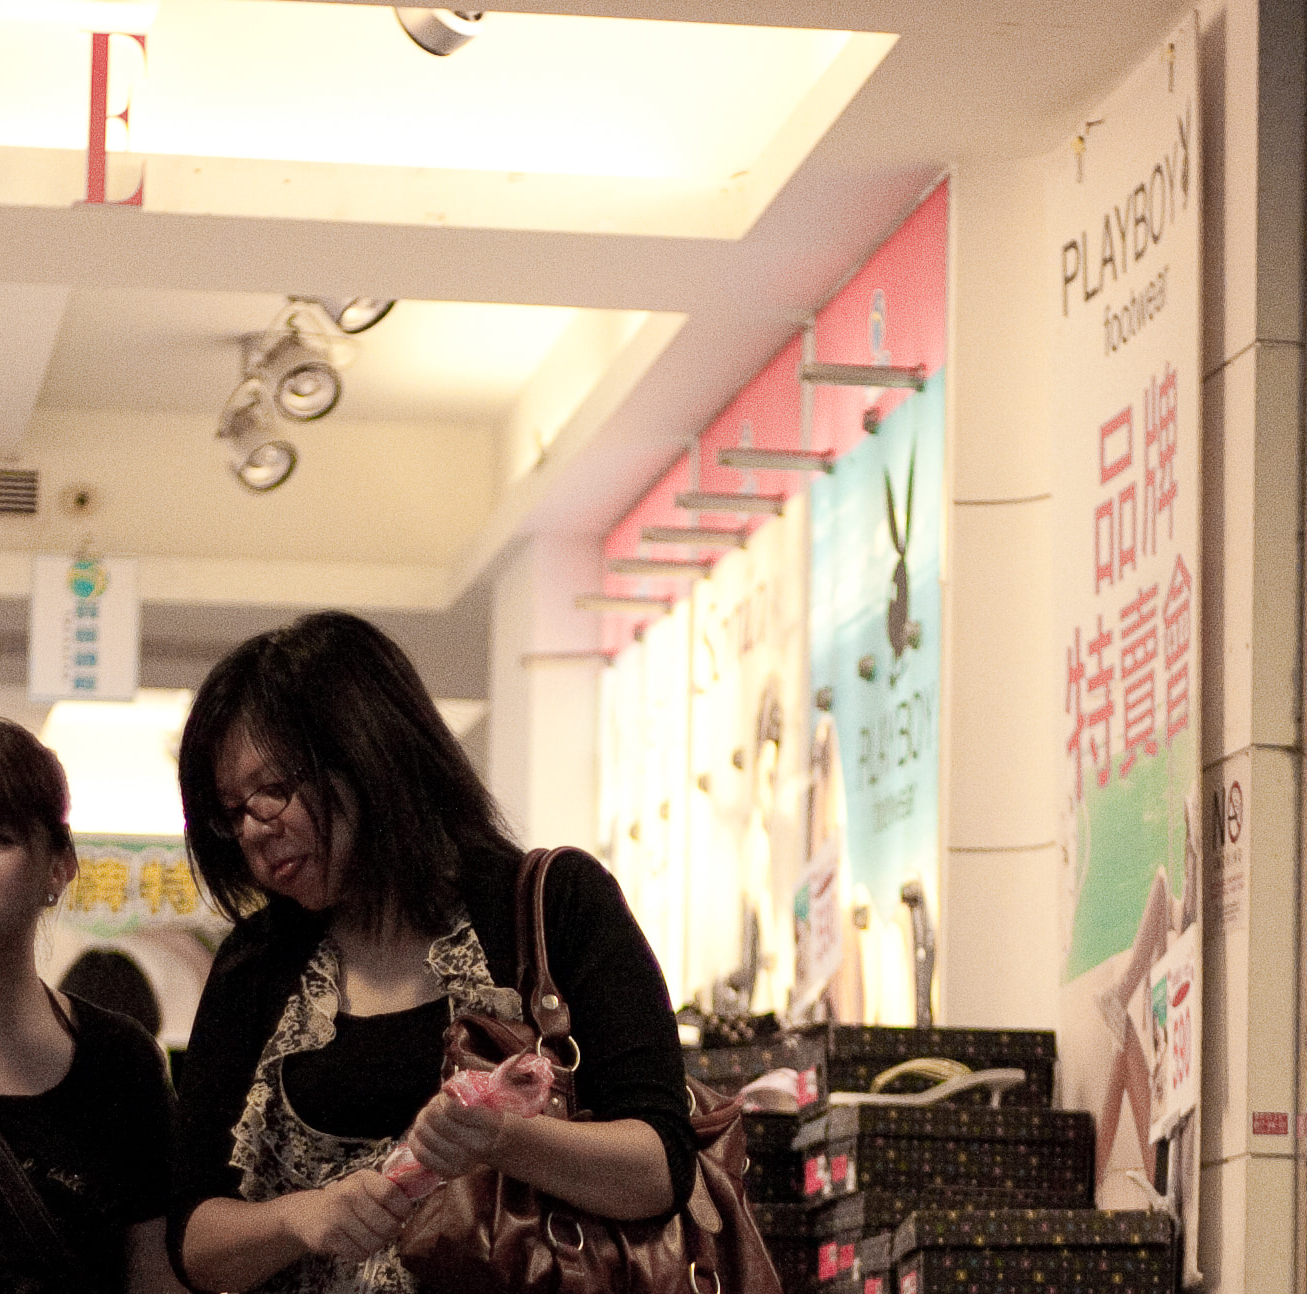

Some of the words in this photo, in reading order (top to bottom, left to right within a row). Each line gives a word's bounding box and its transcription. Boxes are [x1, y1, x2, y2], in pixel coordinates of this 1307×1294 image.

[1061, 141, 1179, 318] PLAYBOY
[1094, 361, 1179, 596] 品牌
[1064, 553, 1192, 800] 特賣會
